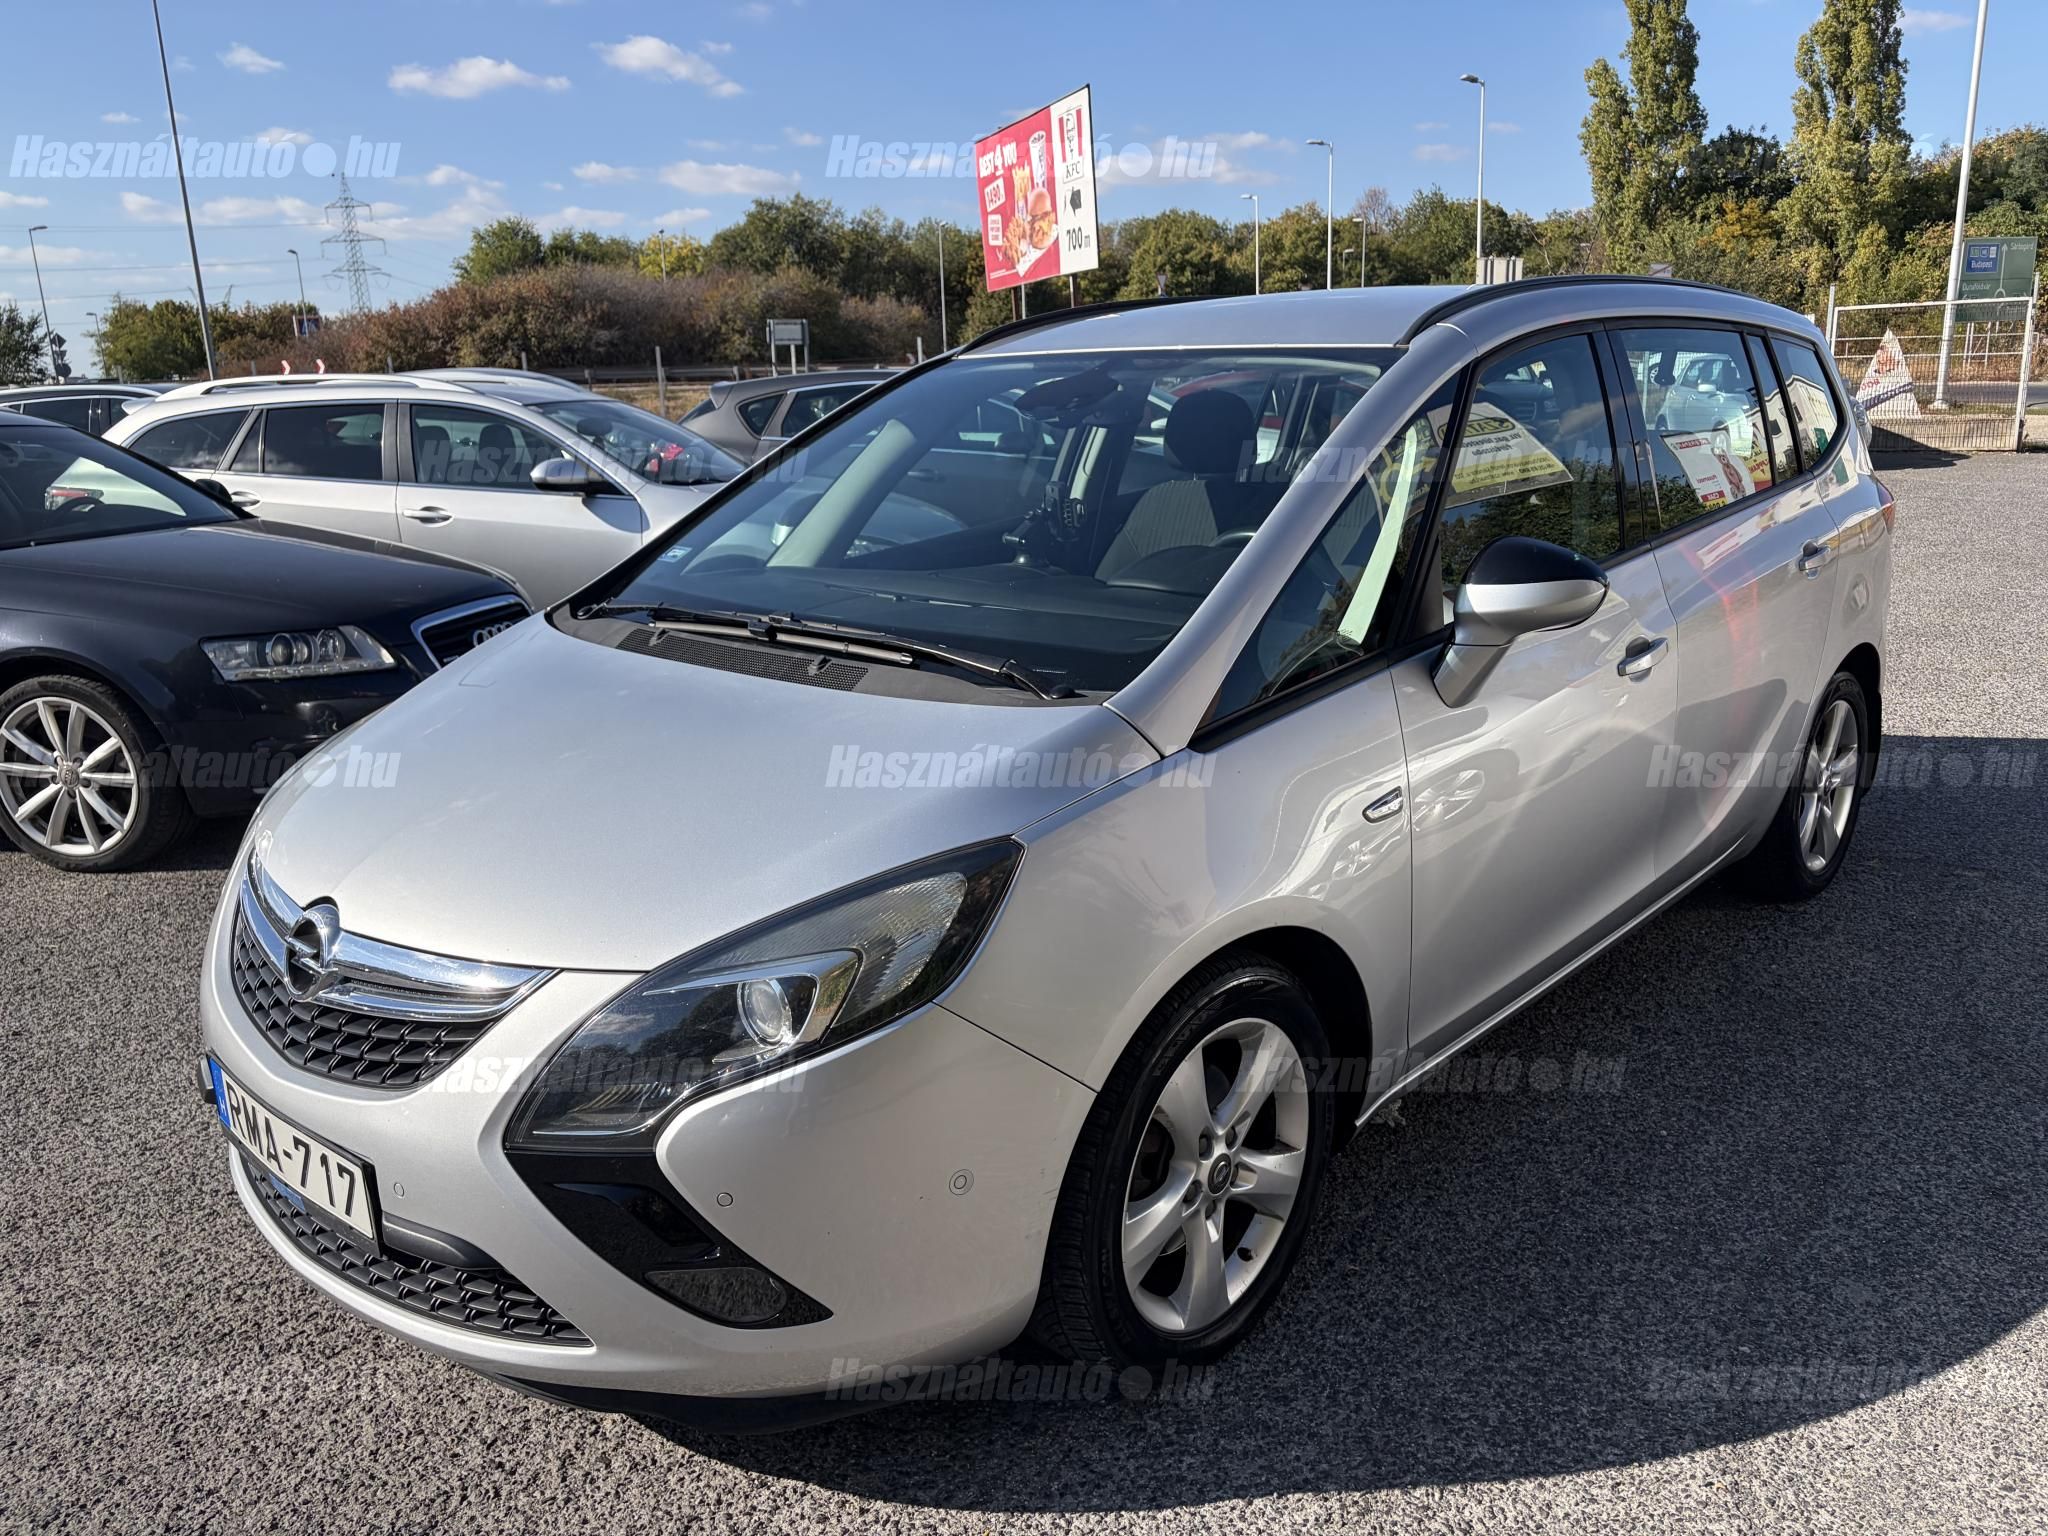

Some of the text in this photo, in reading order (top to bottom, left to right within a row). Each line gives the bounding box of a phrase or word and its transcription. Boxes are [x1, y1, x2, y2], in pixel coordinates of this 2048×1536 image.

[1065, 161, 1080, 178] KFC
[1066, 226, 1083, 252] 700
[225, 1081, 356, 1218] RMA-717
